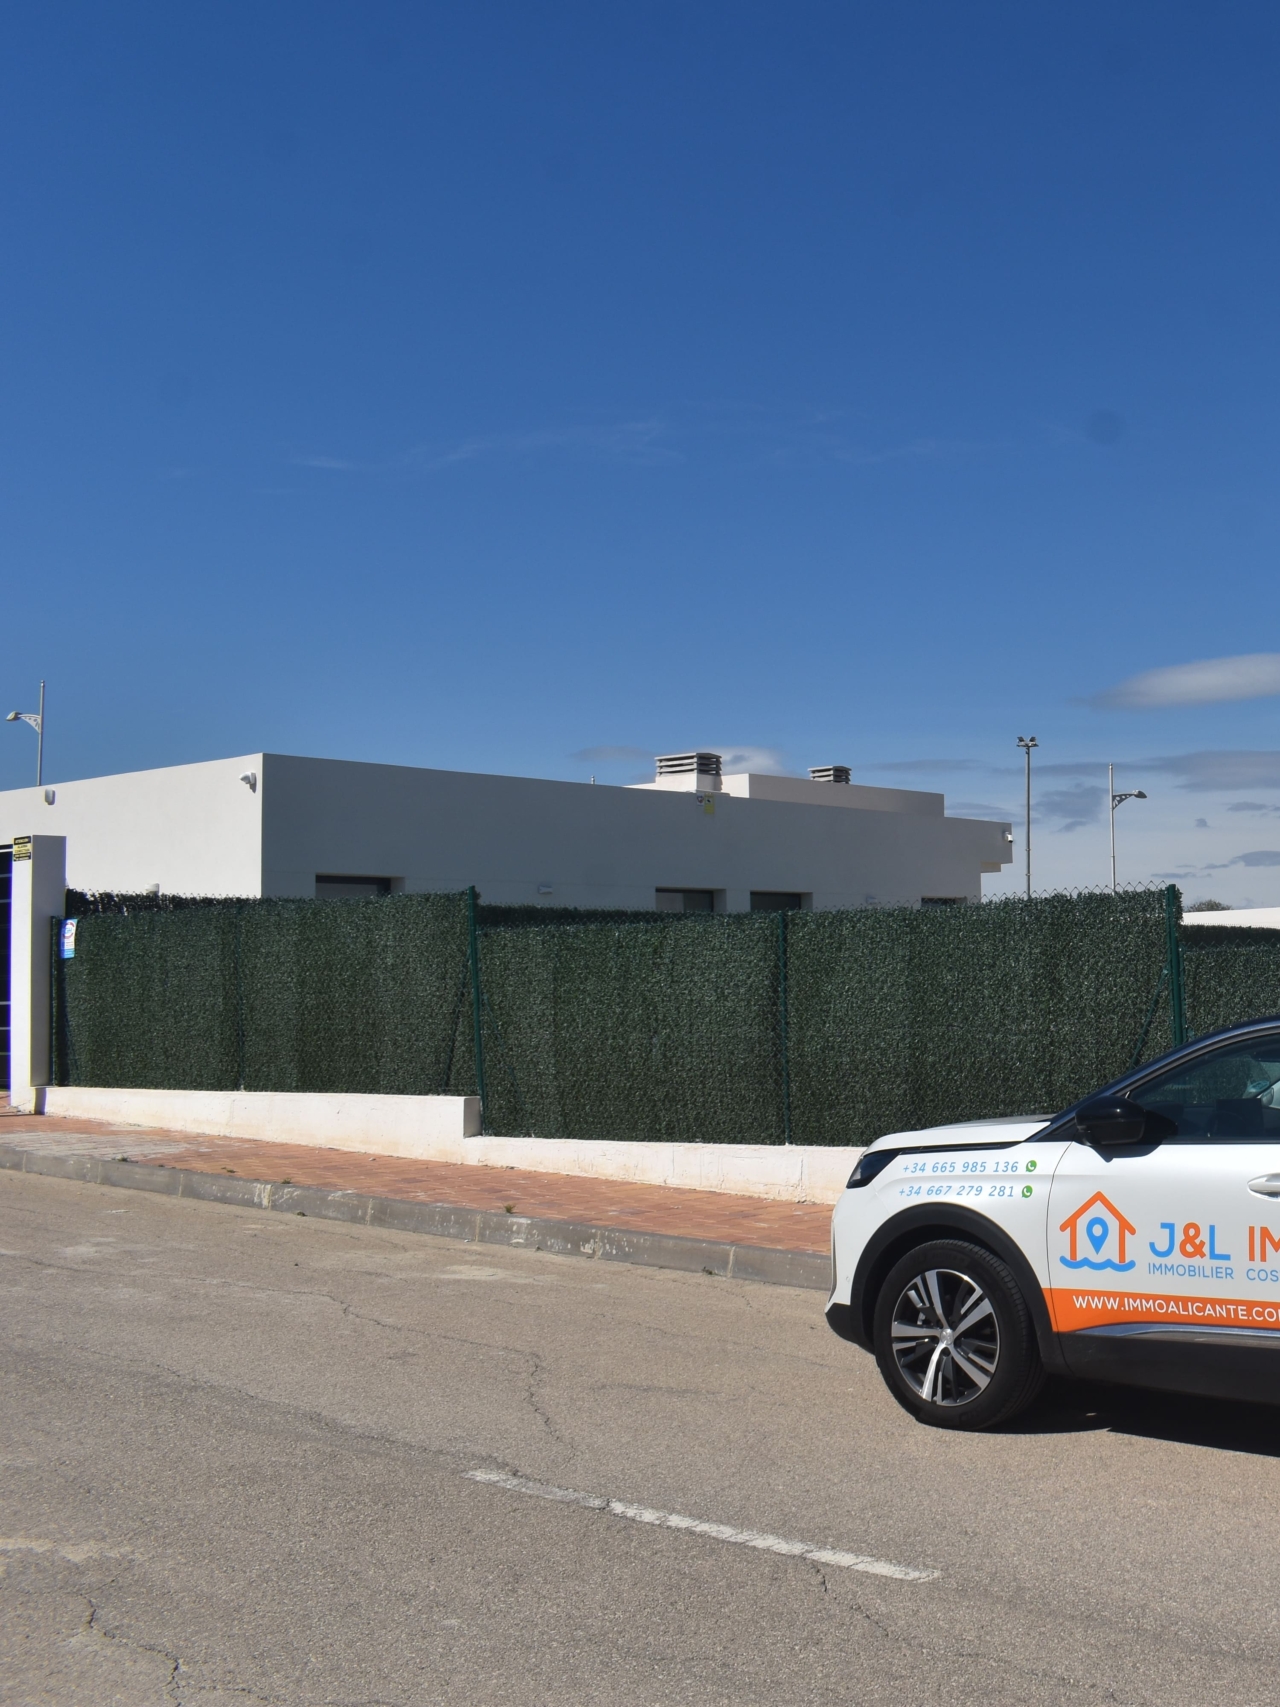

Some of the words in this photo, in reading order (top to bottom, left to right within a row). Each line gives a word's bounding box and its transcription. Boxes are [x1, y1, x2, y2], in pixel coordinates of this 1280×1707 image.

[902, 1162, 927, 1173] +34
[931, 1162, 956, 1173] 665
[961, 1161, 987, 1173] 985
[992, 1161, 1019, 1173] 136
[898, 1185, 922, 1197] +34
[926, 1185, 952, 1196] 667
[956, 1185, 983, 1196] 279
[988, 1185, 1014, 1197] 281
[1148, 1221, 1231, 1261] J&L
[1148, 1262, 1235, 1280] IMMOBILIER
